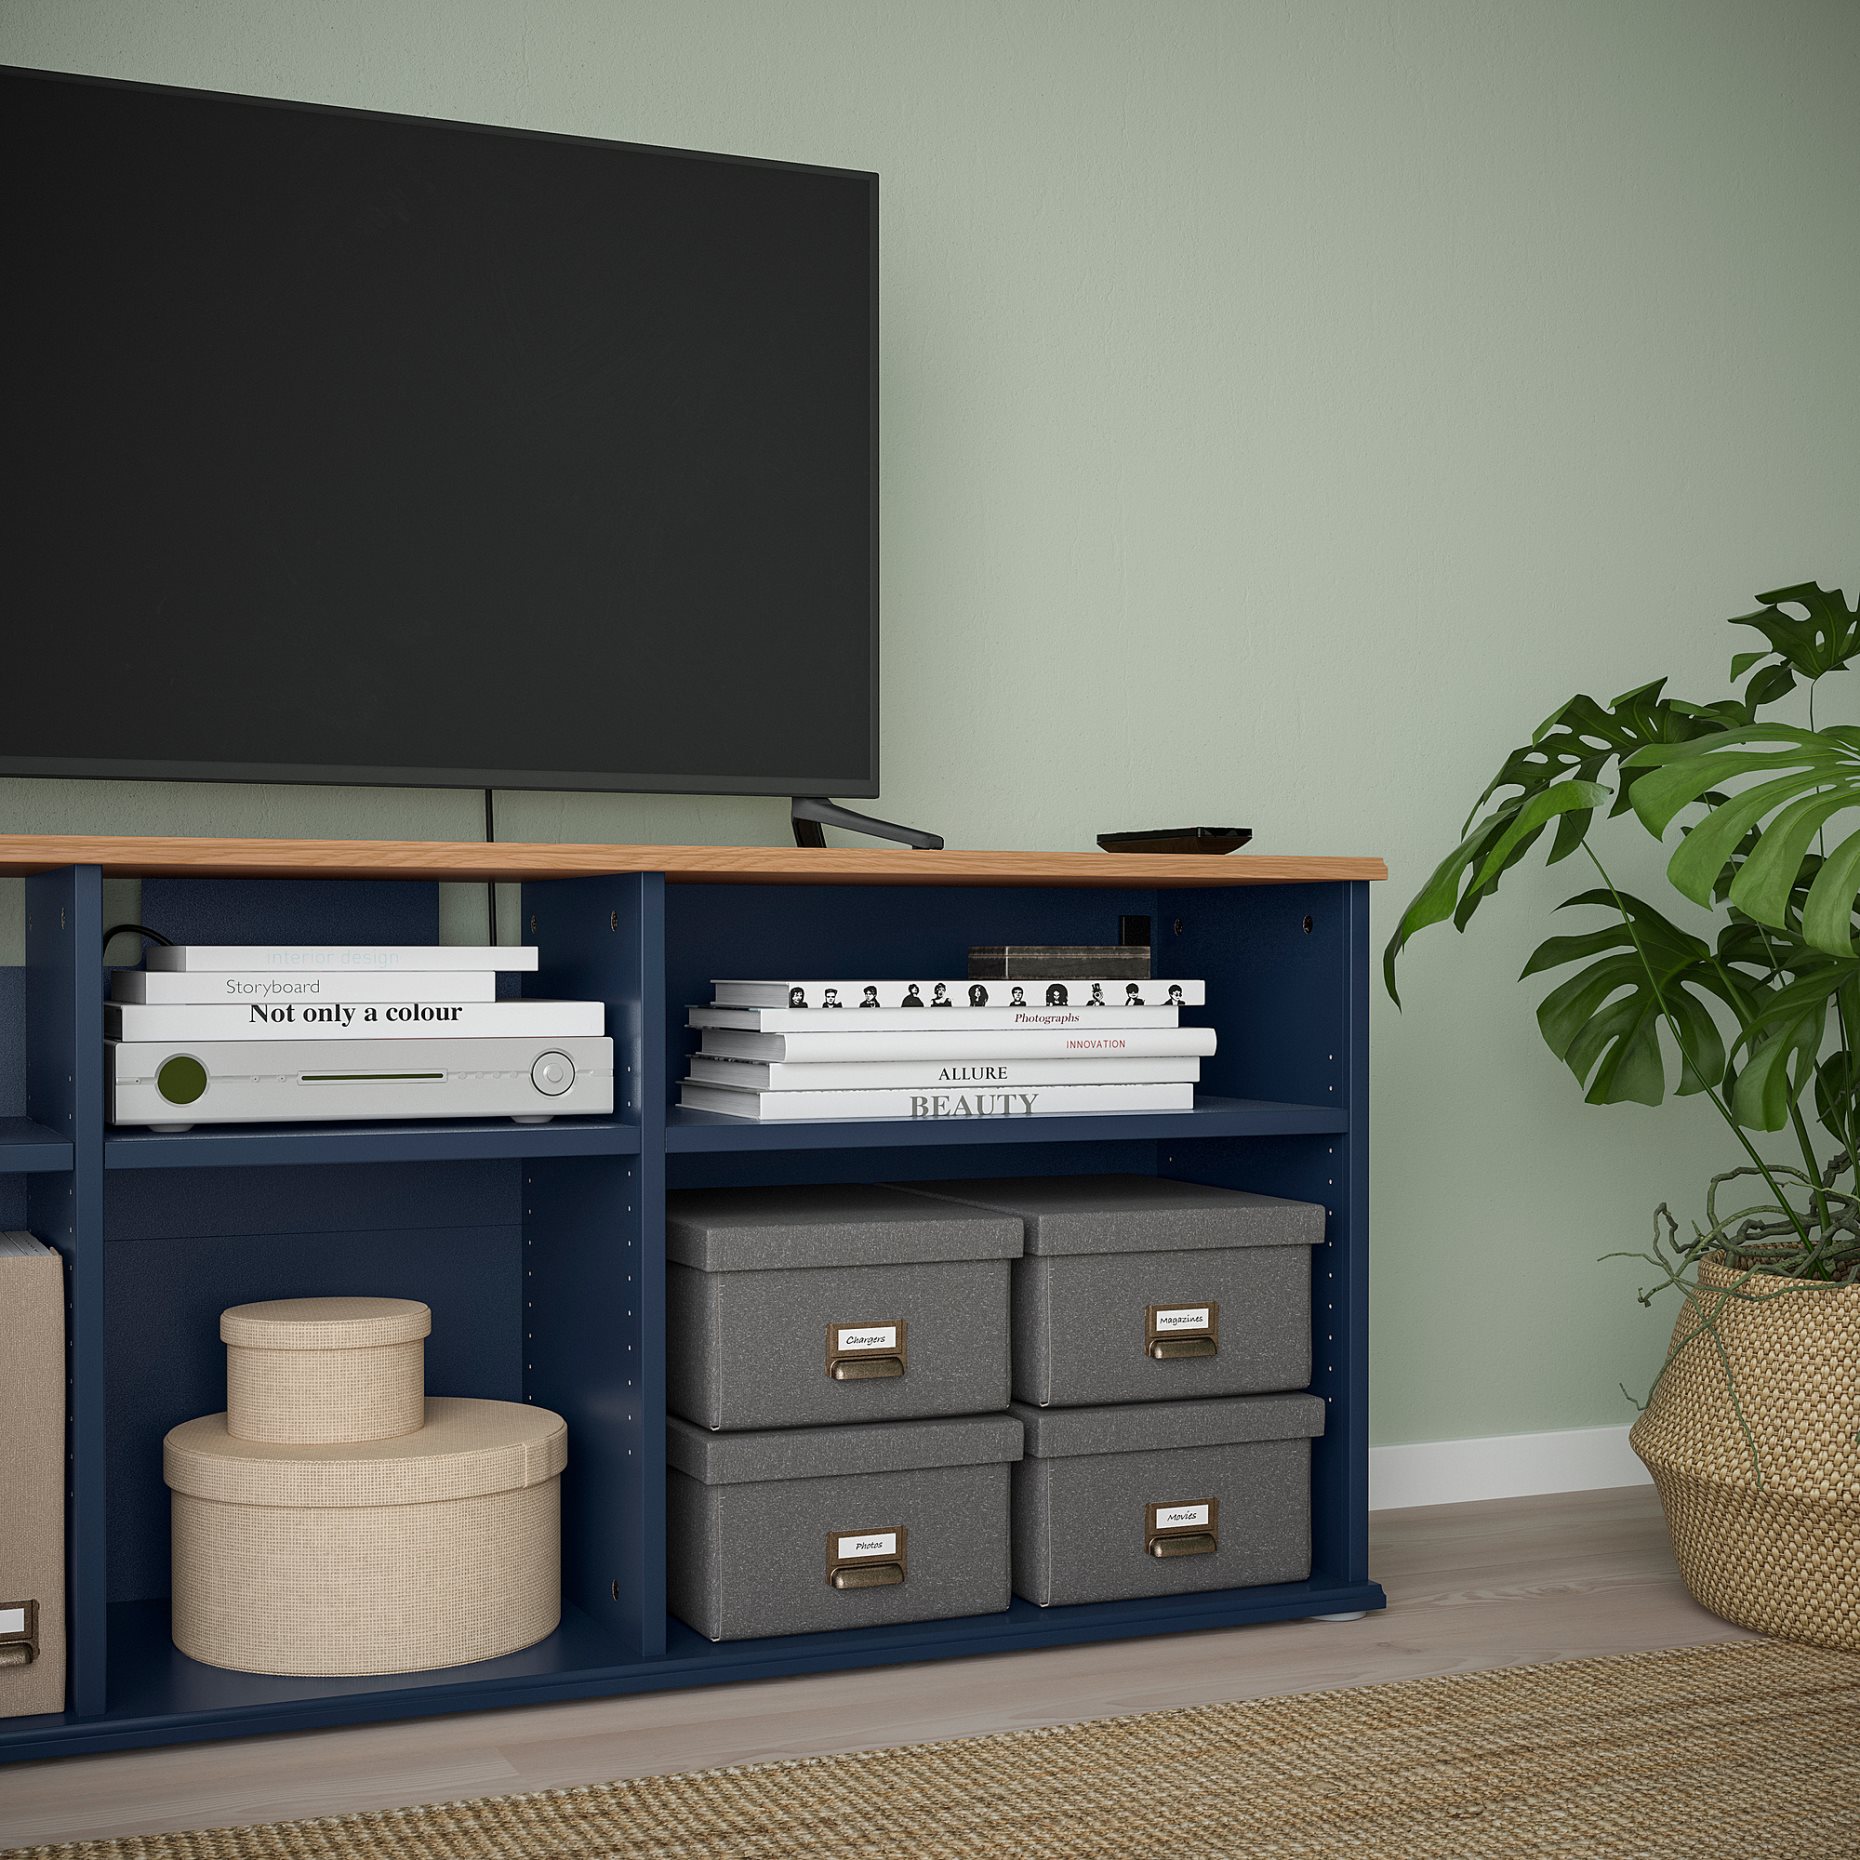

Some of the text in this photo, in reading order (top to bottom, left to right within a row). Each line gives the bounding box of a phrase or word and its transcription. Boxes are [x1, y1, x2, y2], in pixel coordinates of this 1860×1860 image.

[341, 949, 400, 969] design
[226, 979, 320, 998] Storyboard
[249, 1003, 463, 1028] Not only a colour
[1014, 1013, 1080, 1025] Photographs
[1066, 1039, 1126, 1049] INNOVATION
[938, 1066, 1008, 1081] ALLURE
[910, 1093, 1039, 1118] BEAUTY
[1159, 1314, 1204, 1326] Magazines
[845, 1335, 886, 1346] Chargers
[1166, 1510, 1197, 1522] Movies
[855, 1541, 884, 1551] Photos
